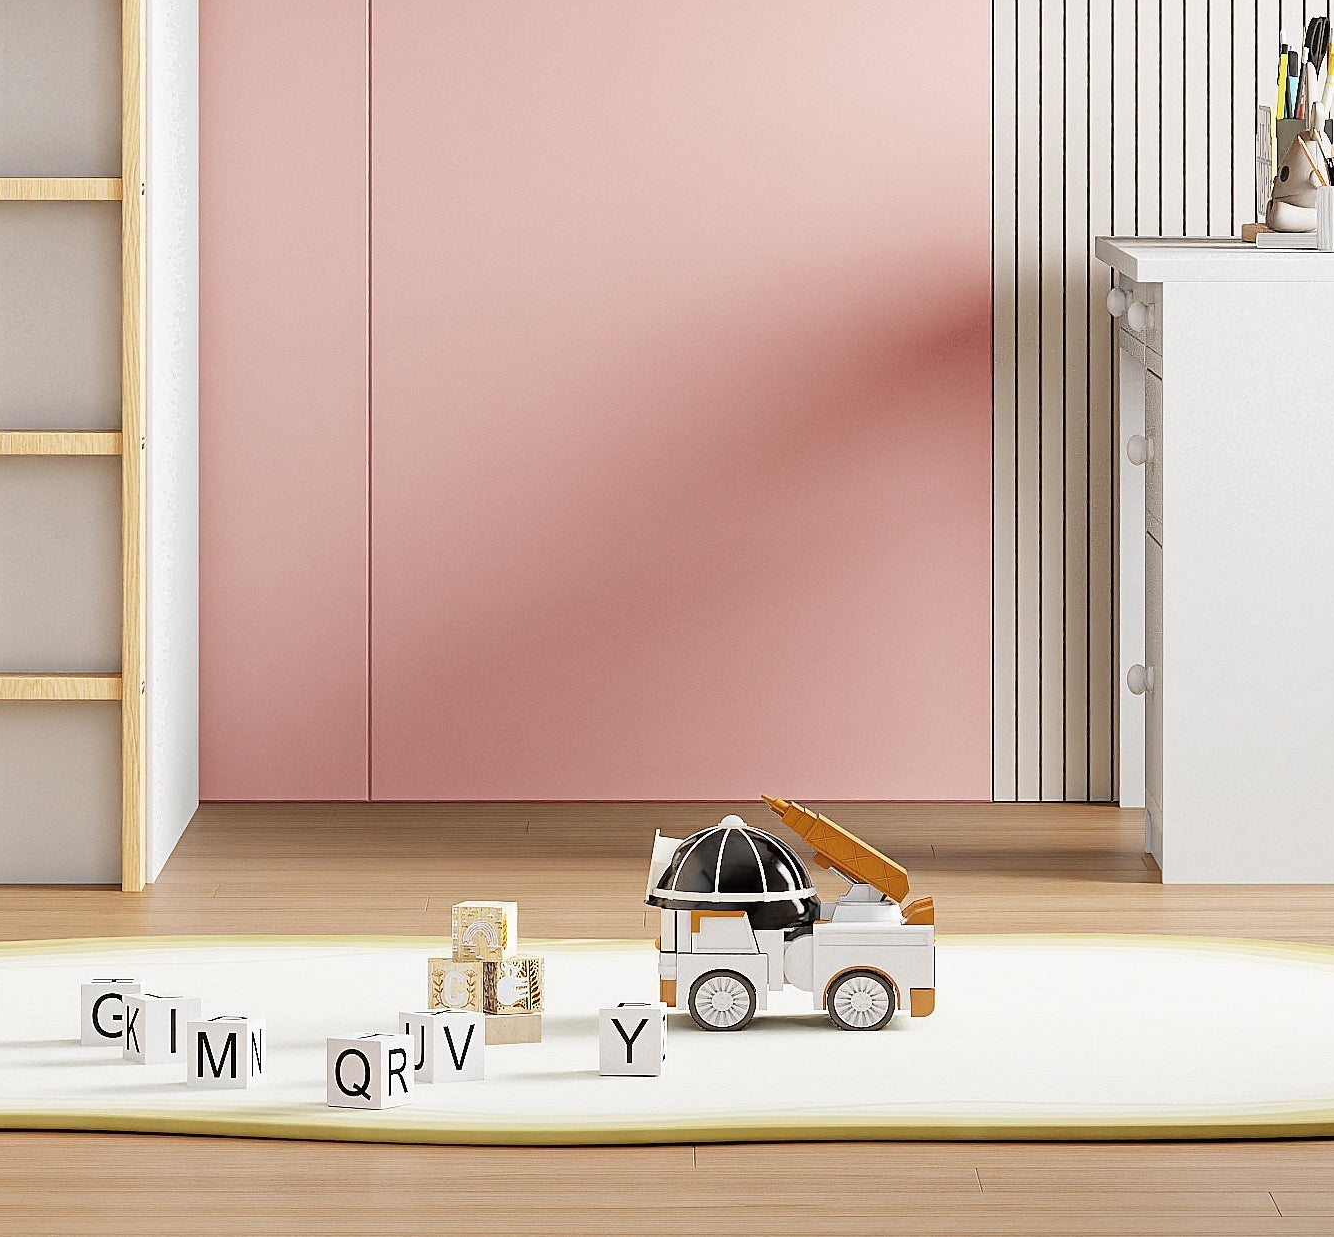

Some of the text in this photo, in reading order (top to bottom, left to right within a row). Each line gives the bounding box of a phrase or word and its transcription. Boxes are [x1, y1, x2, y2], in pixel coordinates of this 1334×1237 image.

[443, 969, 466, 1006] C
[126, 1005, 141, 1054] K
[170, 1008, 177, 1053] I
[251, 1028, 262, 1077] N
[443, 1023, 475, 1071] V
[611, 1018, 649, 1064] Y
[197, 1031, 237, 1078] M
[335, 1048, 371, 1101] Q
[388, 1048, 409, 1096] R
